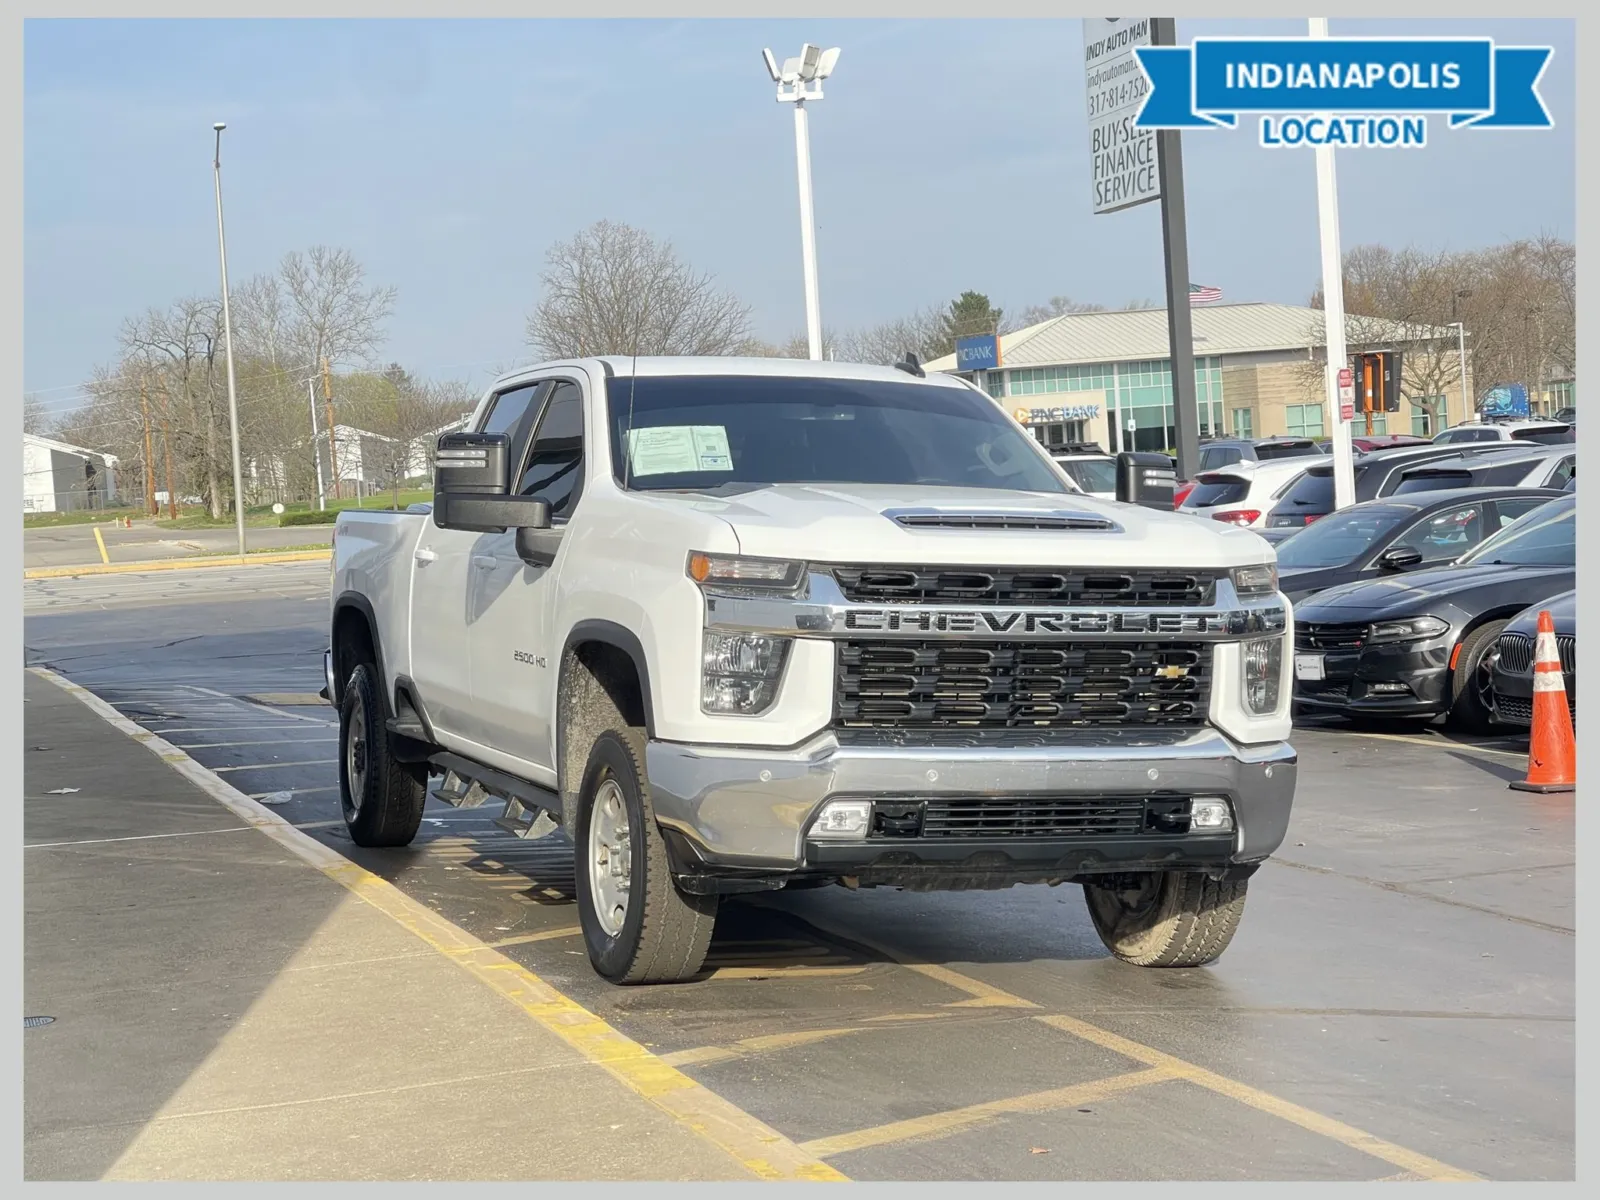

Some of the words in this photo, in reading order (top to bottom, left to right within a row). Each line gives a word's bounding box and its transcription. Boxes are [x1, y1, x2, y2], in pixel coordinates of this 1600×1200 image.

[1086, 38, 1105, 61] INDY
[1106, 28, 1128, 53] AUTO
[1129, 18, 1148, 43] MAN
[1094, 136, 1154, 180] FINANCE
[1096, 164, 1155, 206] SERVICE
[844, 609, 1222, 634] CHEVROLET
[514, 650, 535, 665] 2500
[535, 655, 547, 669] HD
